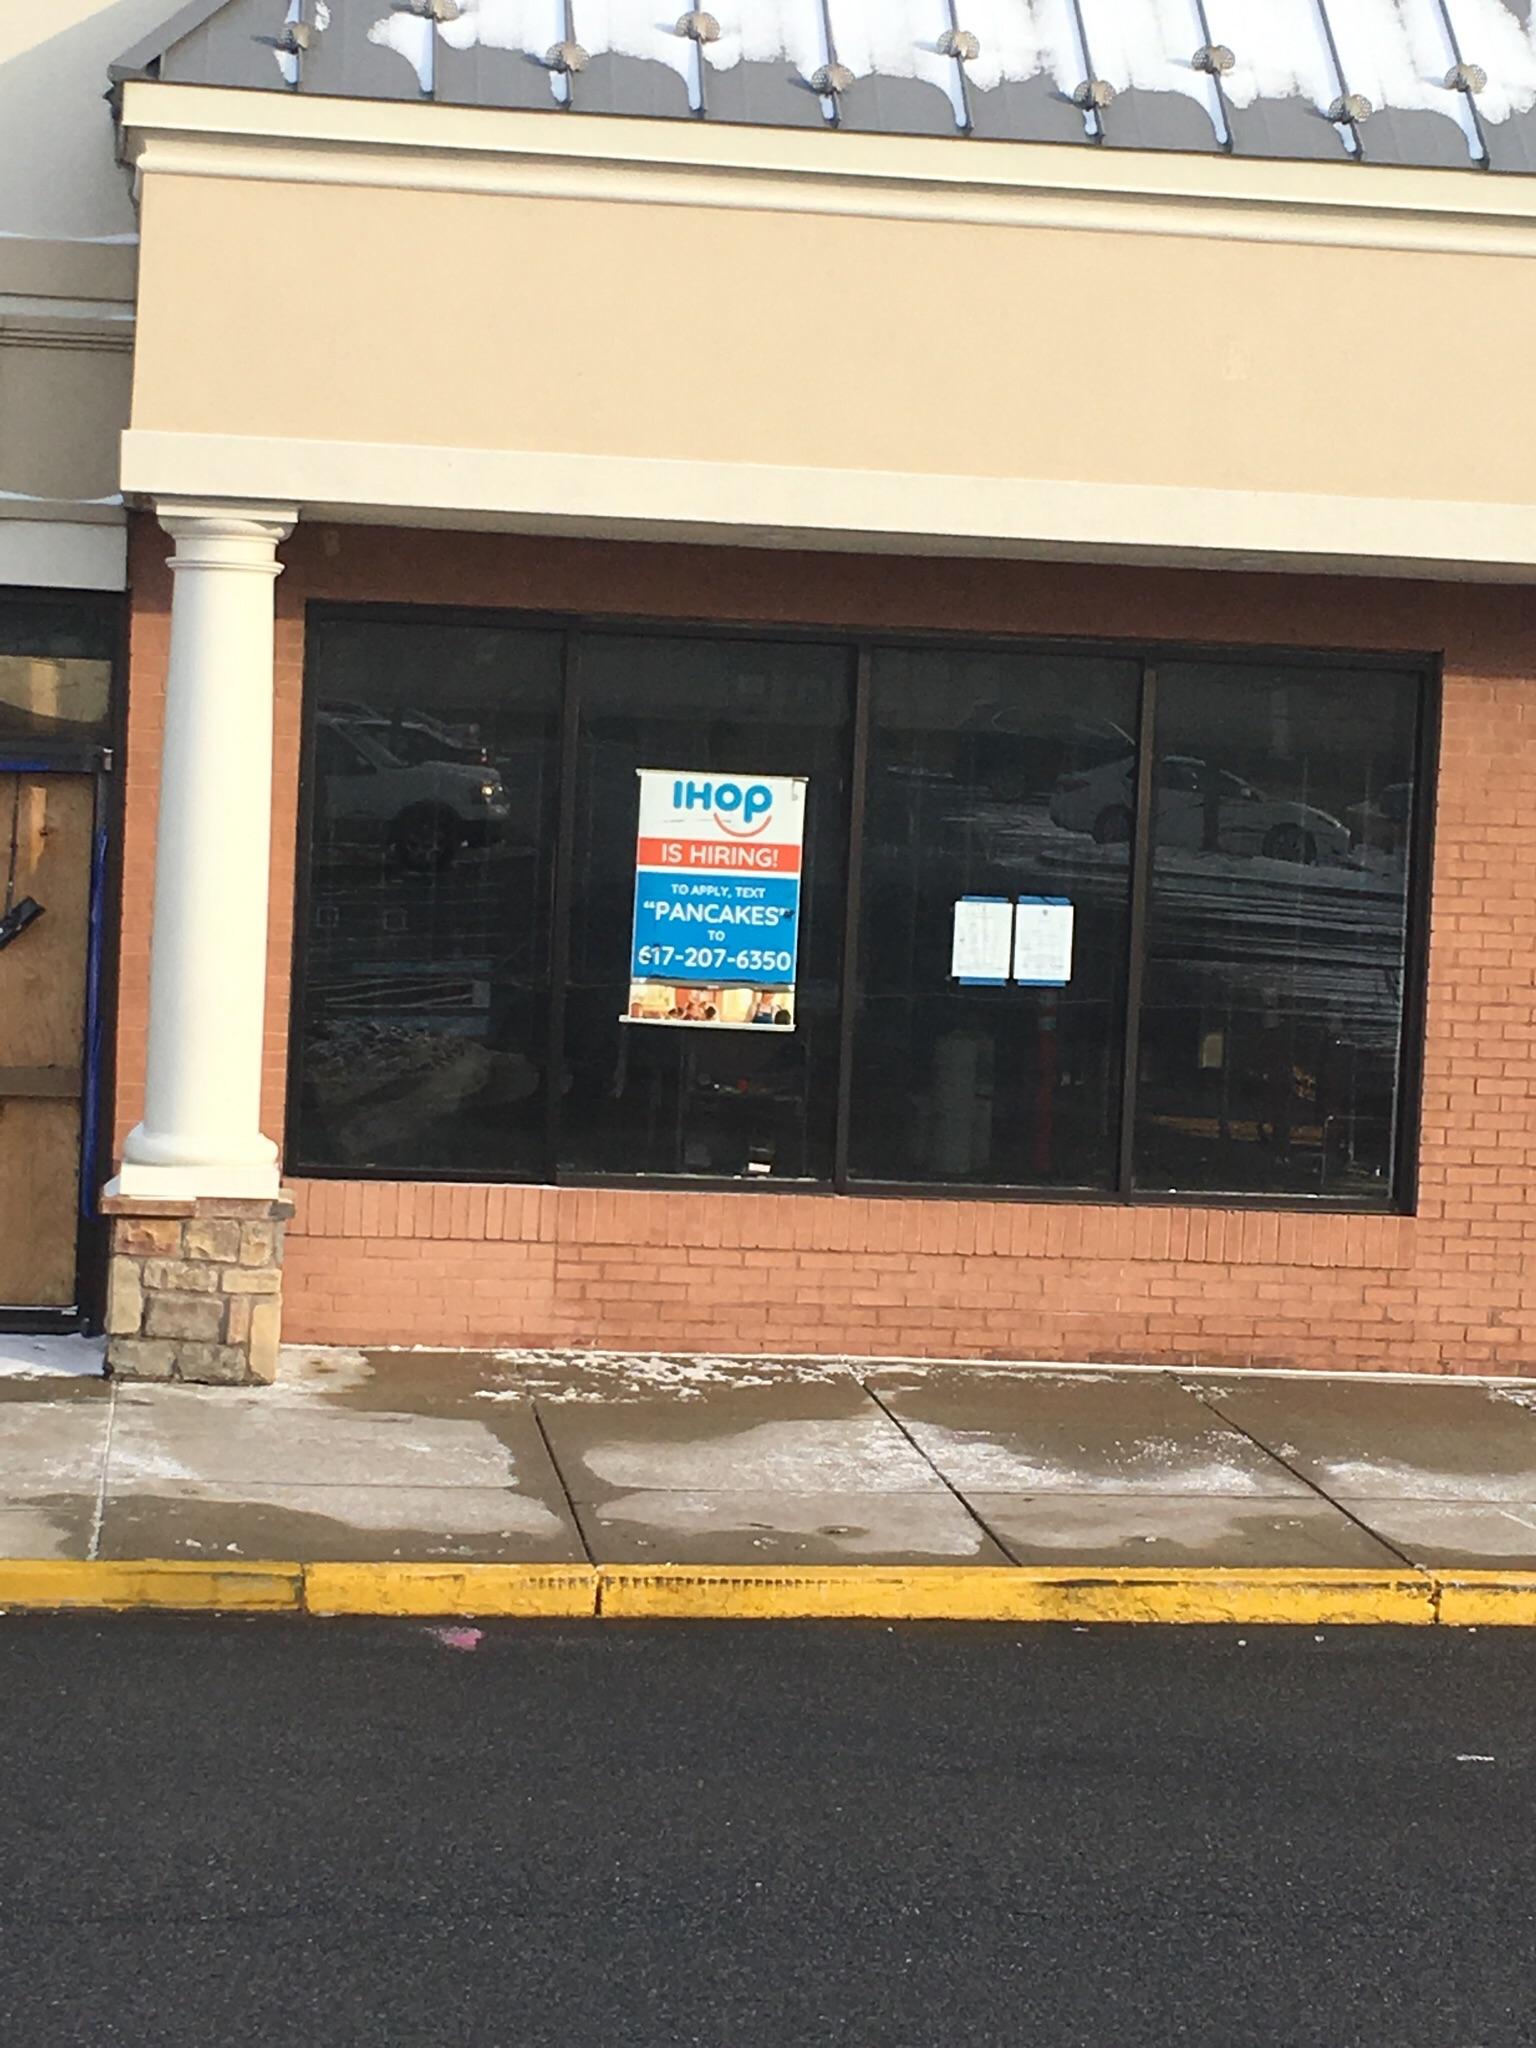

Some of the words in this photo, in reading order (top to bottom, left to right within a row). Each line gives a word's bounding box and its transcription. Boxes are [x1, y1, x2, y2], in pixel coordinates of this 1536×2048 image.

[673, 780, 773, 823] IHOP
[661, 843, 682, 863] IS
[689, 844, 779, 868] HIRING!
[671, 883, 688, 895] TO
[690, 884, 733, 899] APPLY,
[735, 886, 766, 899] TEXT
[707, 929, 726, 942] TO
[637, 945, 792, 972] 617-207-6350
